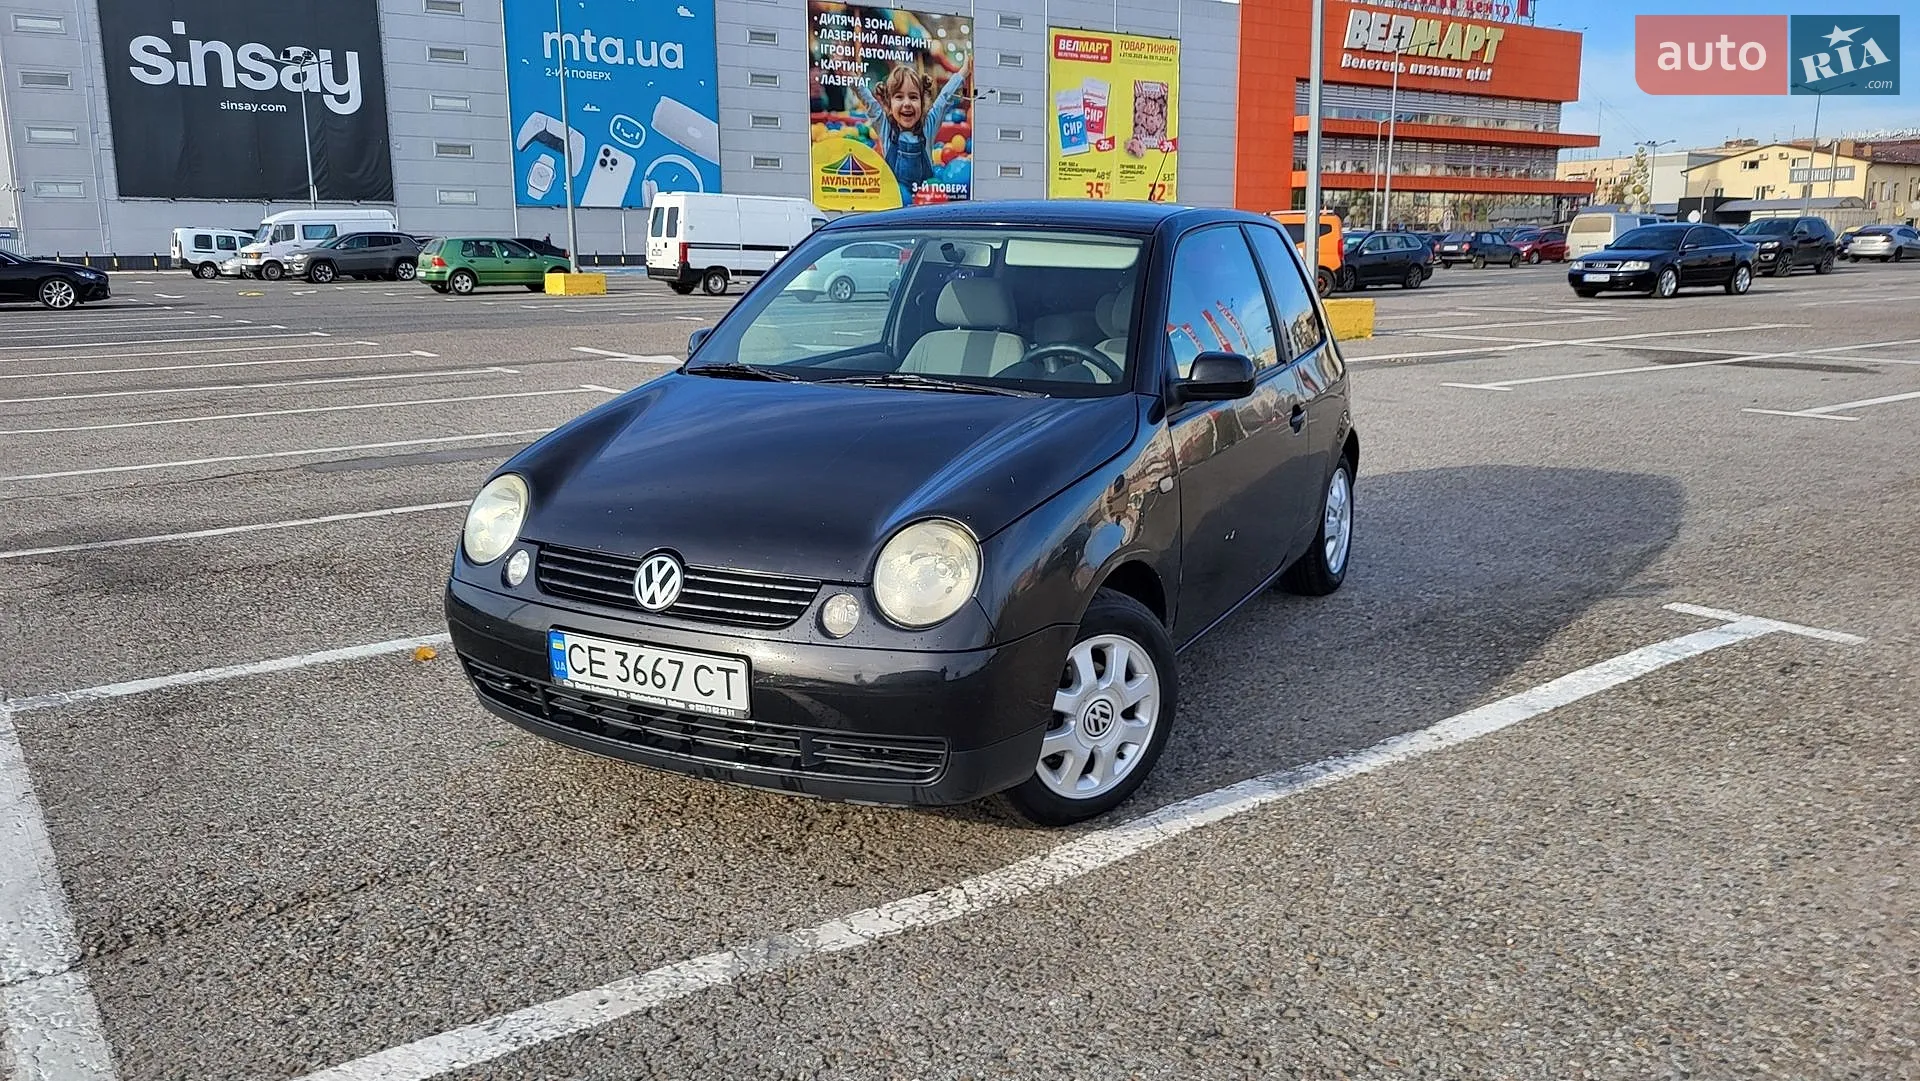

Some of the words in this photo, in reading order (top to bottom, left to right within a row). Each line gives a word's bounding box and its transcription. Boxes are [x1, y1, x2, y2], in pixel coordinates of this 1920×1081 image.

[819, 13, 862, 28] ДИТЯЧА
[865, 18, 895, 31] ЗОНА
[819, 28, 878, 44] ЛАЗЕРНИЙ
[881, 35, 932, 49] ЛАБІРИНТ
[1344, 8, 1505, 64] ВЕЛМАРТ
[543, 29, 684, 70] mta.ua
[820, 44, 855, 57] ІГРОВІ
[859, 49, 914, 62] АВТОМАТИ
[1059, 39, 1109, 54] ВЕЛМАРТ
[1120, 40, 1145, 51] ТОВАР
[129, 20, 362, 115] sinsay
[820, 59, 869, 72] КАРТИНГ
[1341, 52, 1406, 74] Велетень
[1409, 63, 1463, 79] низьких
[1466, 66, 1493, 82] цін!
[571, 69, 612, 81] ПОВЕРХ
[820, 74, 871, 87] ЛАЗЕРТАГ
[220, 100, 287, 113] sinsay.com
[1084, 107, 1103, 122] СИР
[1063, 121, 1083, 136] СИР
[821, 175, 881, 187] МУЛЬТІПАРК
[911, 180, 930, 193] 3-Й
[931, 183, 968, 194] ПОВЕРХ
[1086, 181, 1104, 199] 35
[554, 660, 566, 672] UA
[568, 643, 608, 680] CE
[614, 650, 684, 692] 3667
[693, 664, 739, 701] CT
